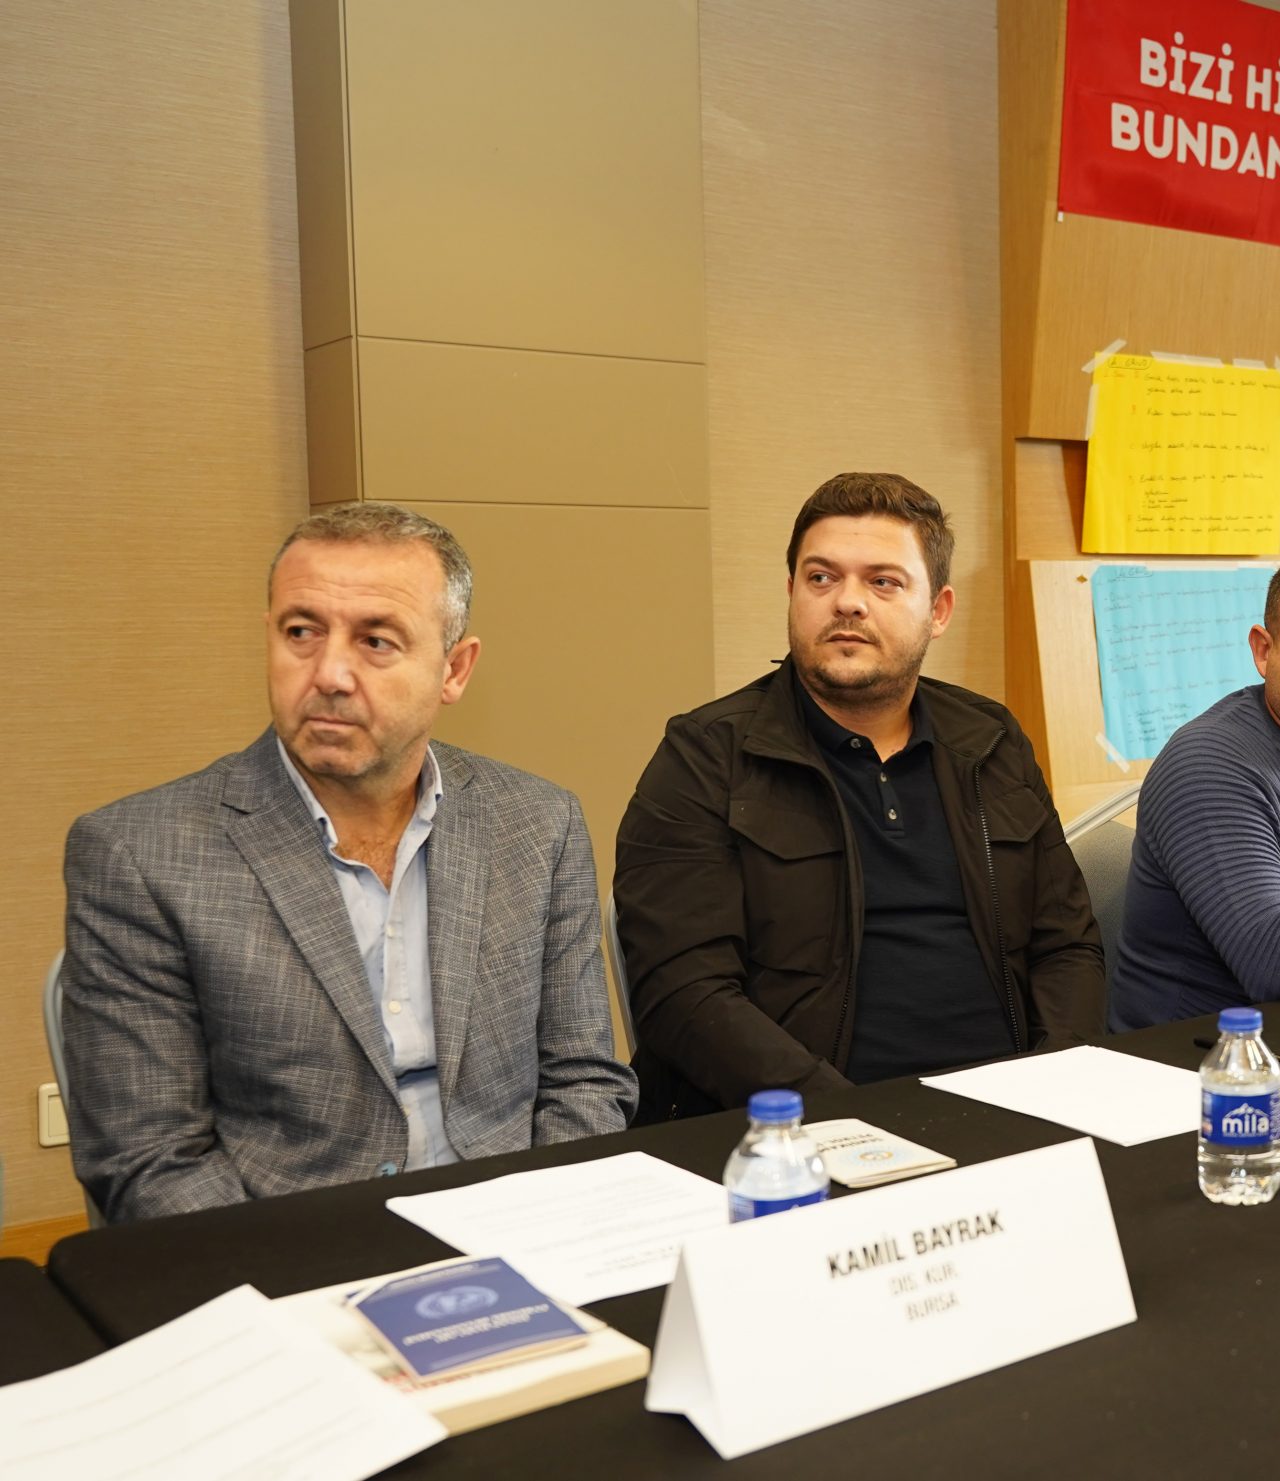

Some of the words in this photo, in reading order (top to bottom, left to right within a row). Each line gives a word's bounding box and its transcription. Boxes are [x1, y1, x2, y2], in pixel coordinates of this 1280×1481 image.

[1140, 31, 1235, 105] BİZİ
[1222, 1113, 1269, 1134] mila
[827, 1232, 906, 1278] KAMİL
[912, 1210, 1004, 1255] BAYRAK
[906, 1291, 960, 1322] BURSA
